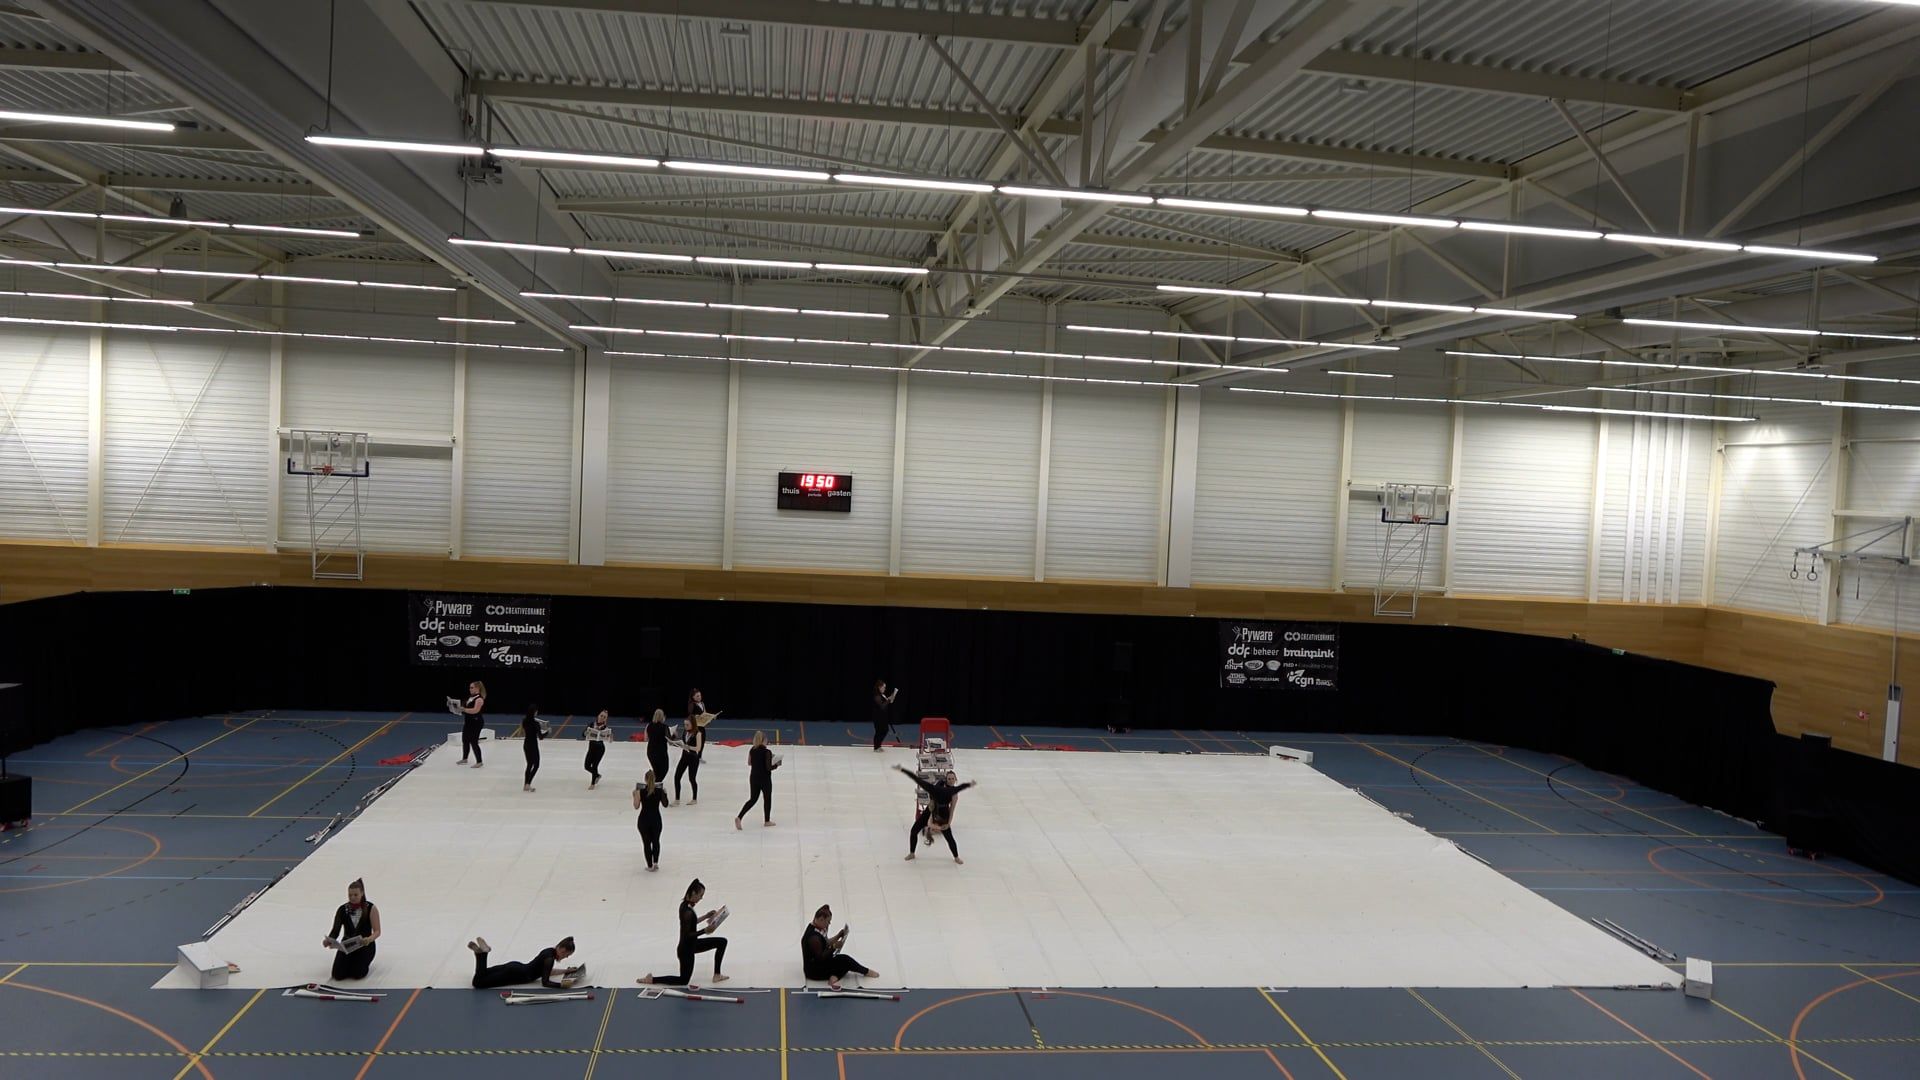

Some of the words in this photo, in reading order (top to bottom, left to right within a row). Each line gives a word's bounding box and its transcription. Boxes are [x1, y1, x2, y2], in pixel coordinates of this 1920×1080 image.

[782, 487, 800, 495] thuis
[827, 489, 851, 497] gasten
[435, 600, 472, 616] Pyware
[419, 617, 445, 633] ddf
[448, 621, 480, 631] beheer
[484, 622, 545, 635] brainpink
[1242, 627, 1273, 642] Pyware
[1228, 643, 1250, 658] ddf
[1253, 647, 1280, 656] beheer
[1283, 647, 1335, 659] brainpink
[498, 653, 521, 666] cgn
[1295, 675, 1314, 688] cgn
